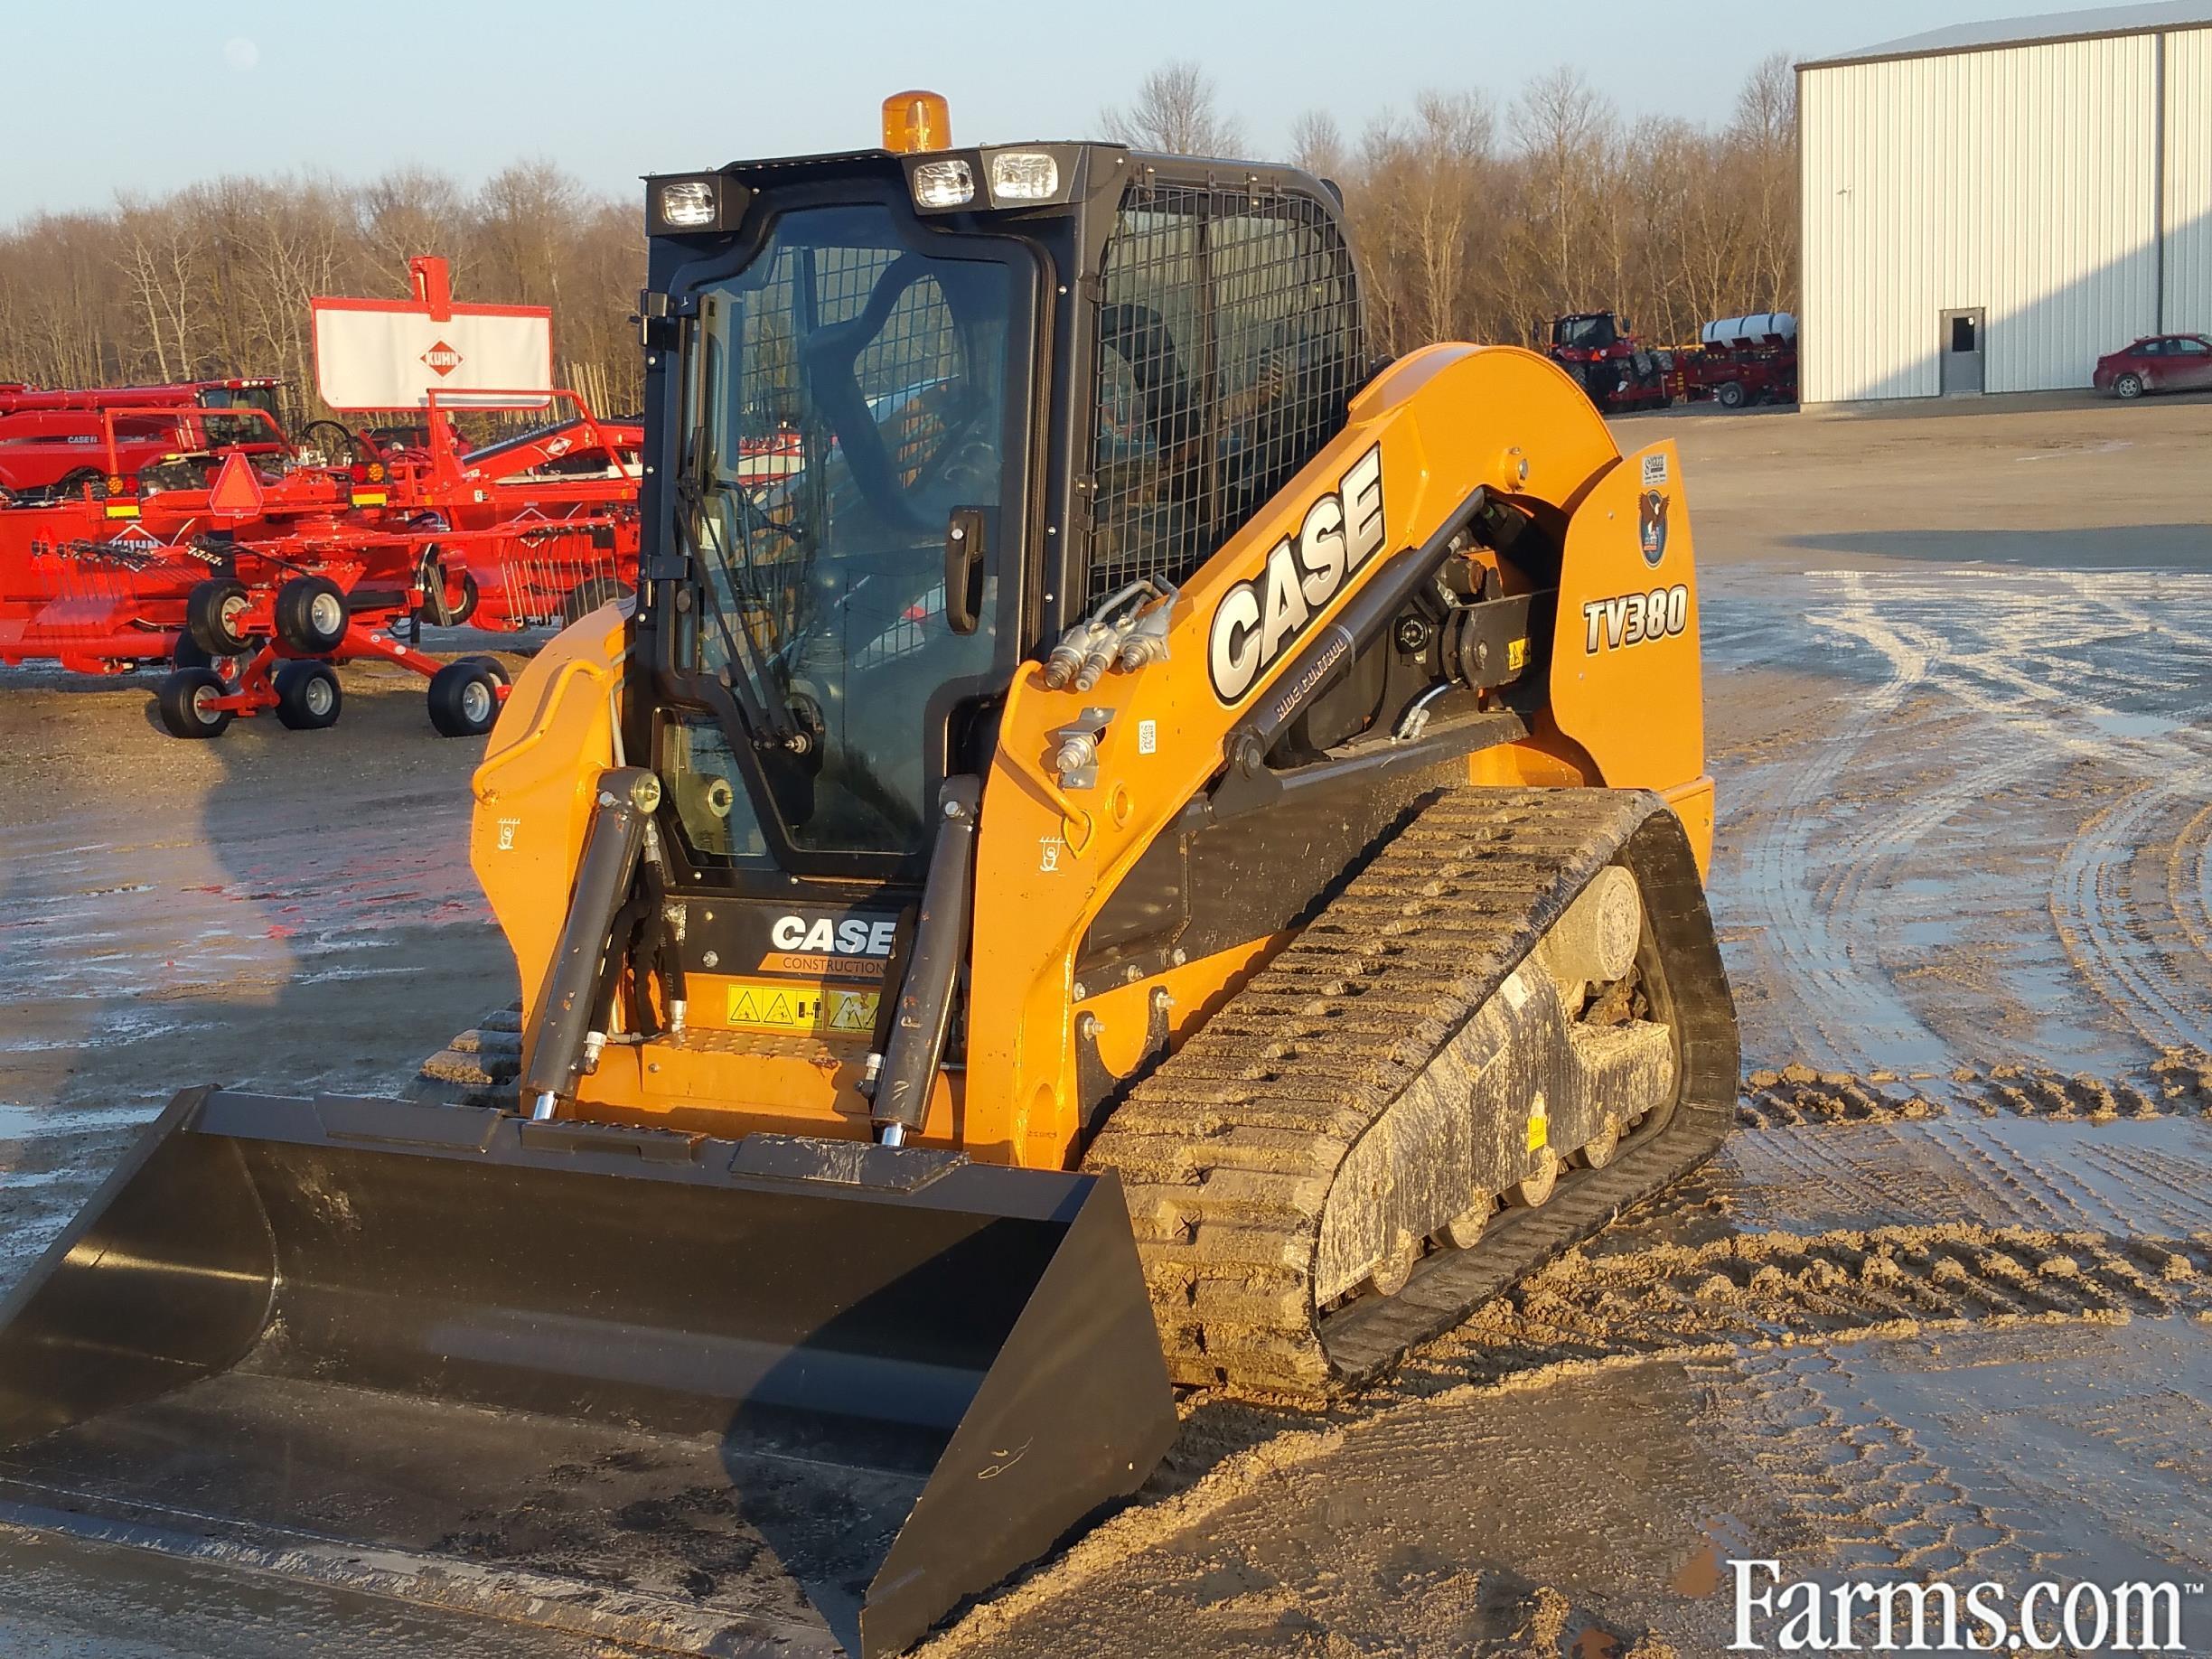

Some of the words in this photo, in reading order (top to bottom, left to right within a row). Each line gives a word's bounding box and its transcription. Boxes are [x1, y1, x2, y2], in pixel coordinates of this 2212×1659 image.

[425, 351, 459, 366] KUHN
[1210, 441, 1383, 699] CASE
[1584, 584, 1688, 654] TV380
[1275, 686, 1302, 723] RIDE
[1301, 638, 1347, 693] CONTROL
[772, 915, 897, 954] CASE
[783, 957, 886, 974] CONSTRUCTION
